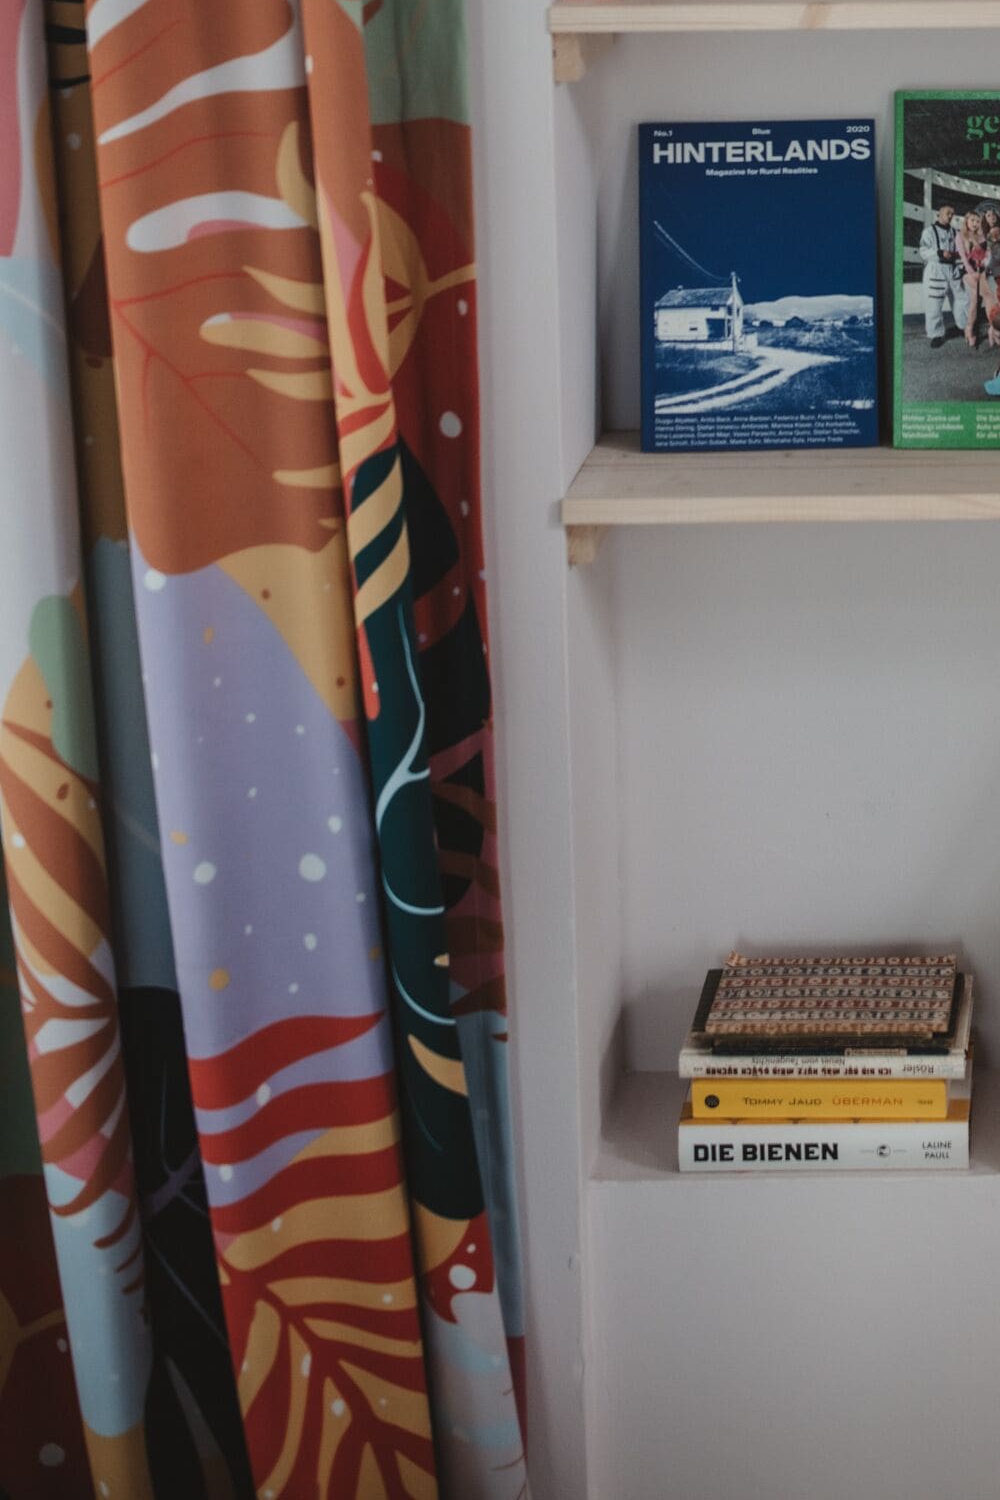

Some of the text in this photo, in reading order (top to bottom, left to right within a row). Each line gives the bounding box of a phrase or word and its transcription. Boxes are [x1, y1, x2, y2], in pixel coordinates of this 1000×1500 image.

[751, 124, 870, 135] Blue 2020
[653, 138, 871, 164] HINTERLANDS
[705, 166, 818, 177] Magazine for Rural Realities
[901, 1063, 934, 1074] Rösler
[743, 1097, 822, 1106] TOMMY JAUD
[922, 1140, 952, 1149] LALINE
[693, 1142, 838, 1161] DIE BIENEN
